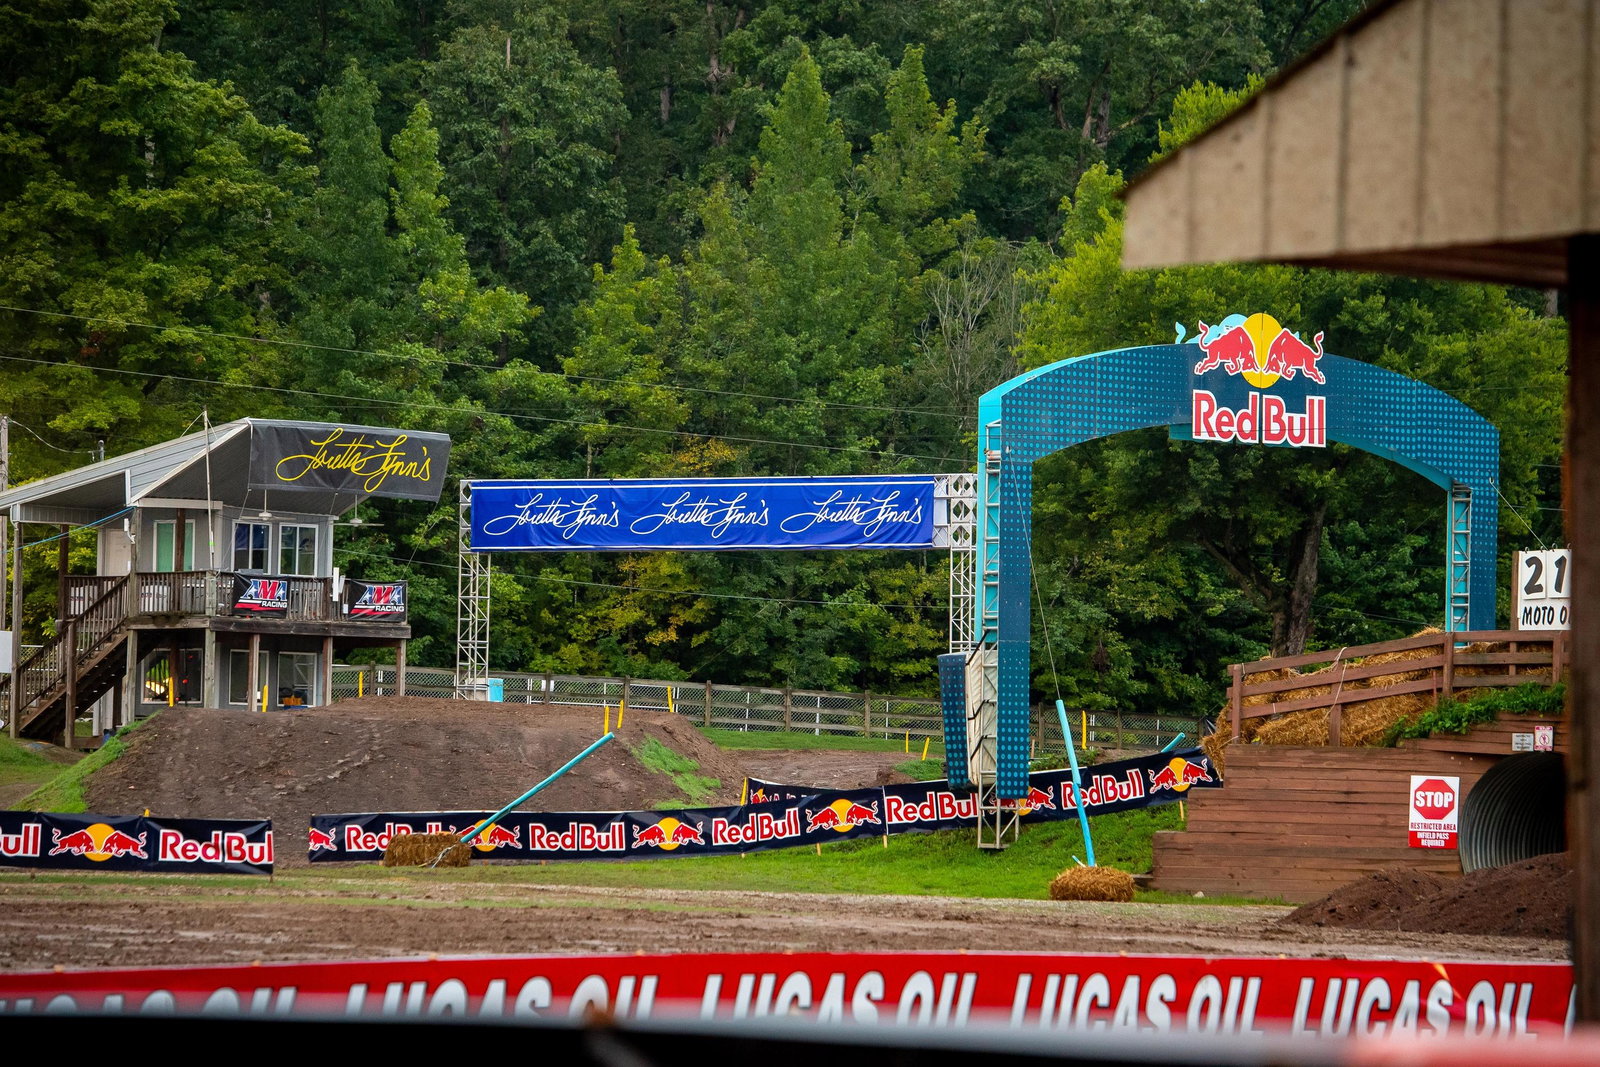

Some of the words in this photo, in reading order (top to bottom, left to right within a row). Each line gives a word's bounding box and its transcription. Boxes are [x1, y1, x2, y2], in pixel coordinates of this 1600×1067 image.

[1193, 389, 1259, 443] Red
[1263, 394, 1326, 448] Bull
[275, 427, 374, 481] Loretta
[350, 434, 430, 492] Lynn's
[484, 493, 570, 535] Loretta
[555, 494, 619, 539] Lynn's
[630, 491, 718, 534] Loretta
[701, 492, 769, 538] Lynn's
[780, 490, 871, 533] Loretta
[854, 490, 922, 537] Lynn's
[242, 579, 288, 600] AMA
[356, 585, 403, 605] AMA
[1522, 606, 1554, 625] MOTO
[1560, 606, 1570, 625] O
[1102, 768, 1145, 804] Bull
[1415, 791, 1453, 808] STOP
[885, 791, 937, 824] Red
[937, 791, 985, 820] Bul
[0, 823, 42, 857] ull
[345, 823, 394, 852] Red
[529, 823, 577, 850] Red
[579, 822, 625, 851] Bull
[712, 813, 757, 846] Red
[758, 807, 801, 841] Bull
[159, 829, 223, 862] Red
[1010, 973, 1177, 1032] LUCAS
[1187, 975, 1265, 1036] OIL
[1291, 977, 1453, 1041] LUCAS
[1464, 980, 1538, 1042] OIL
